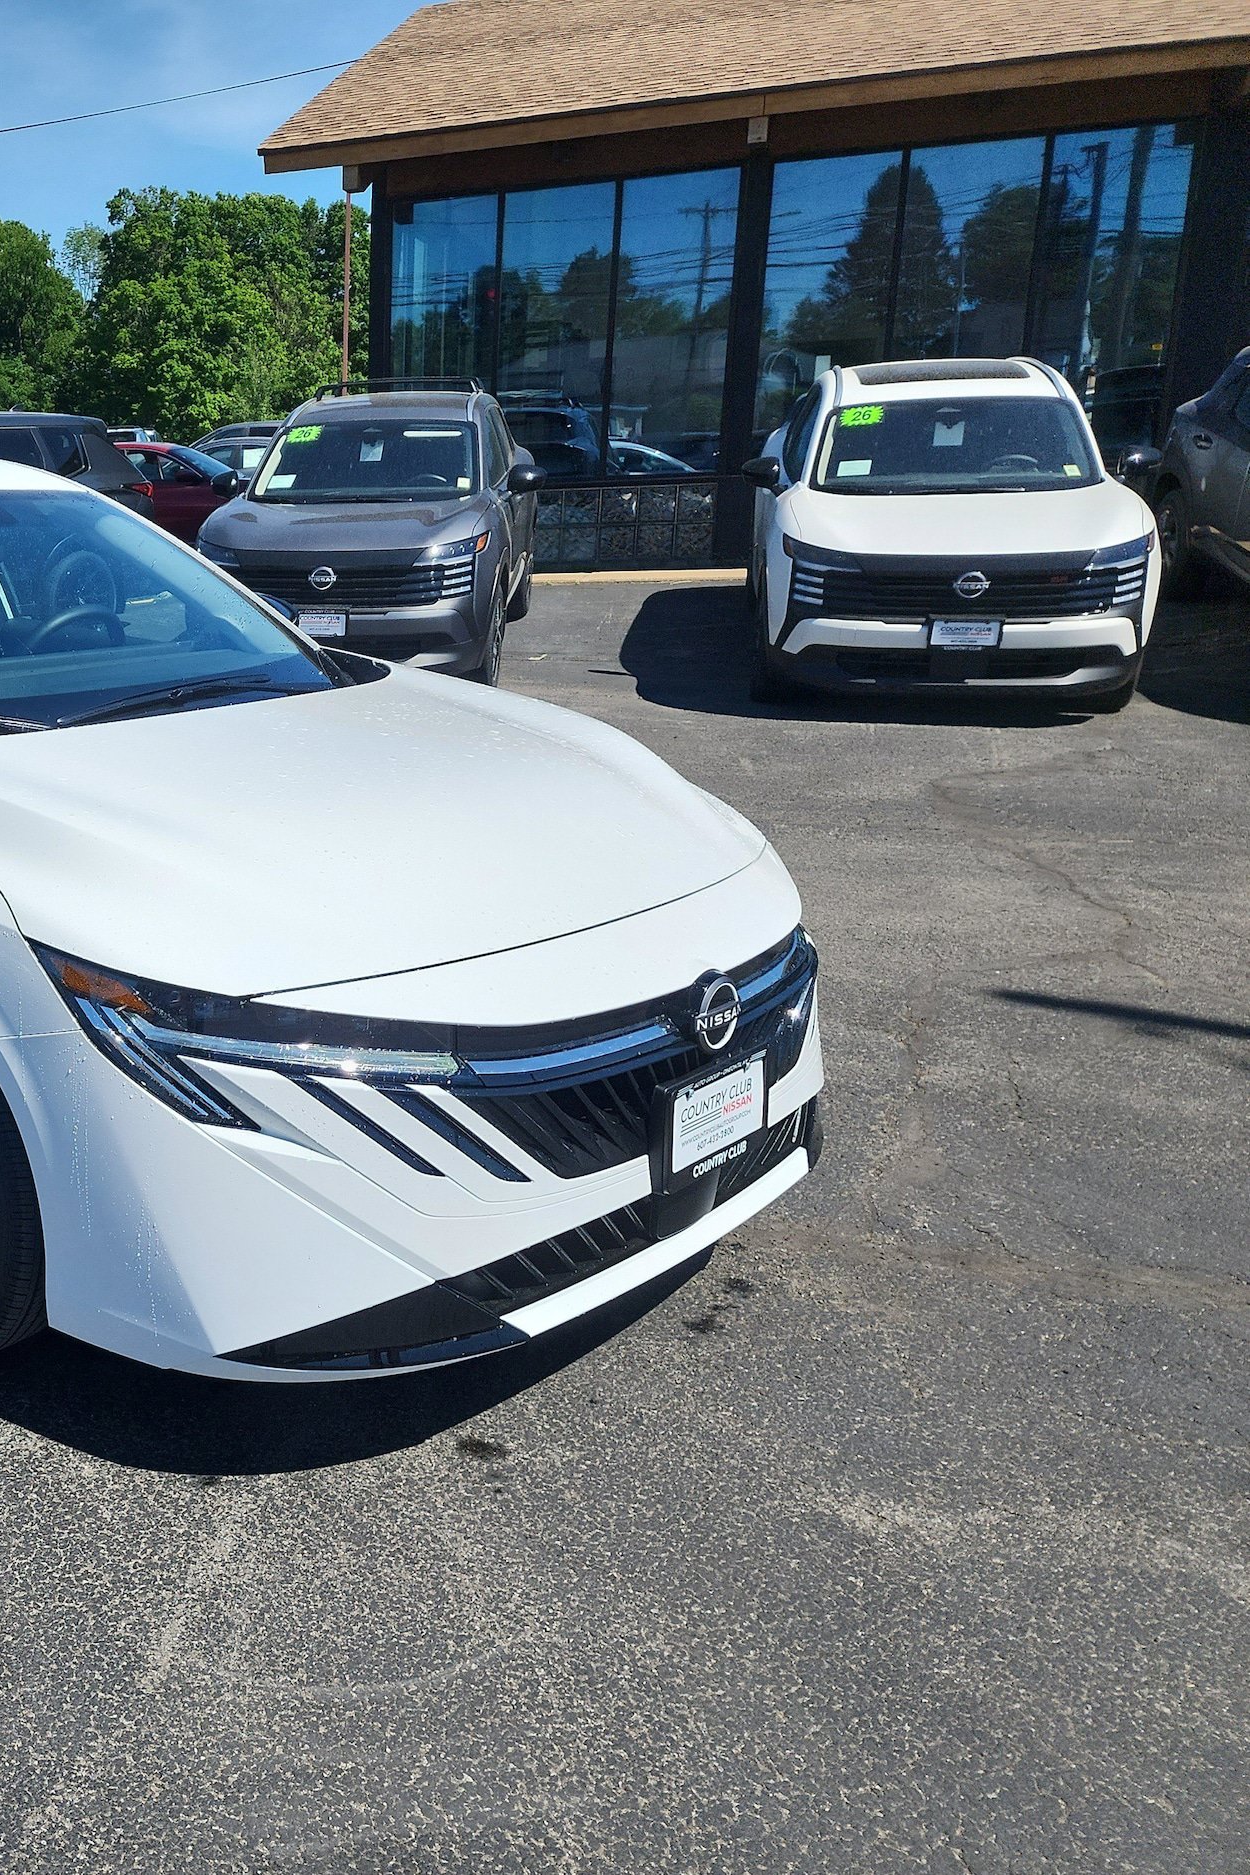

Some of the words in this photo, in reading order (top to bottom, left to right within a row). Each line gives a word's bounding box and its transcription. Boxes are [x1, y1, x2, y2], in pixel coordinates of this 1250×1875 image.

[851, 410, 872, 421] 26
[295, 429, 312, 438] 26
[681, 1089, 728, 1123] COUNTRY
[729, 1078, 752, 1099] CLUB
[722, 1094, 752, 1116] NISSAN
[693, 1149, 730, 1179] COUNTRY
[728, 1139, 748, 1160] CLUB
